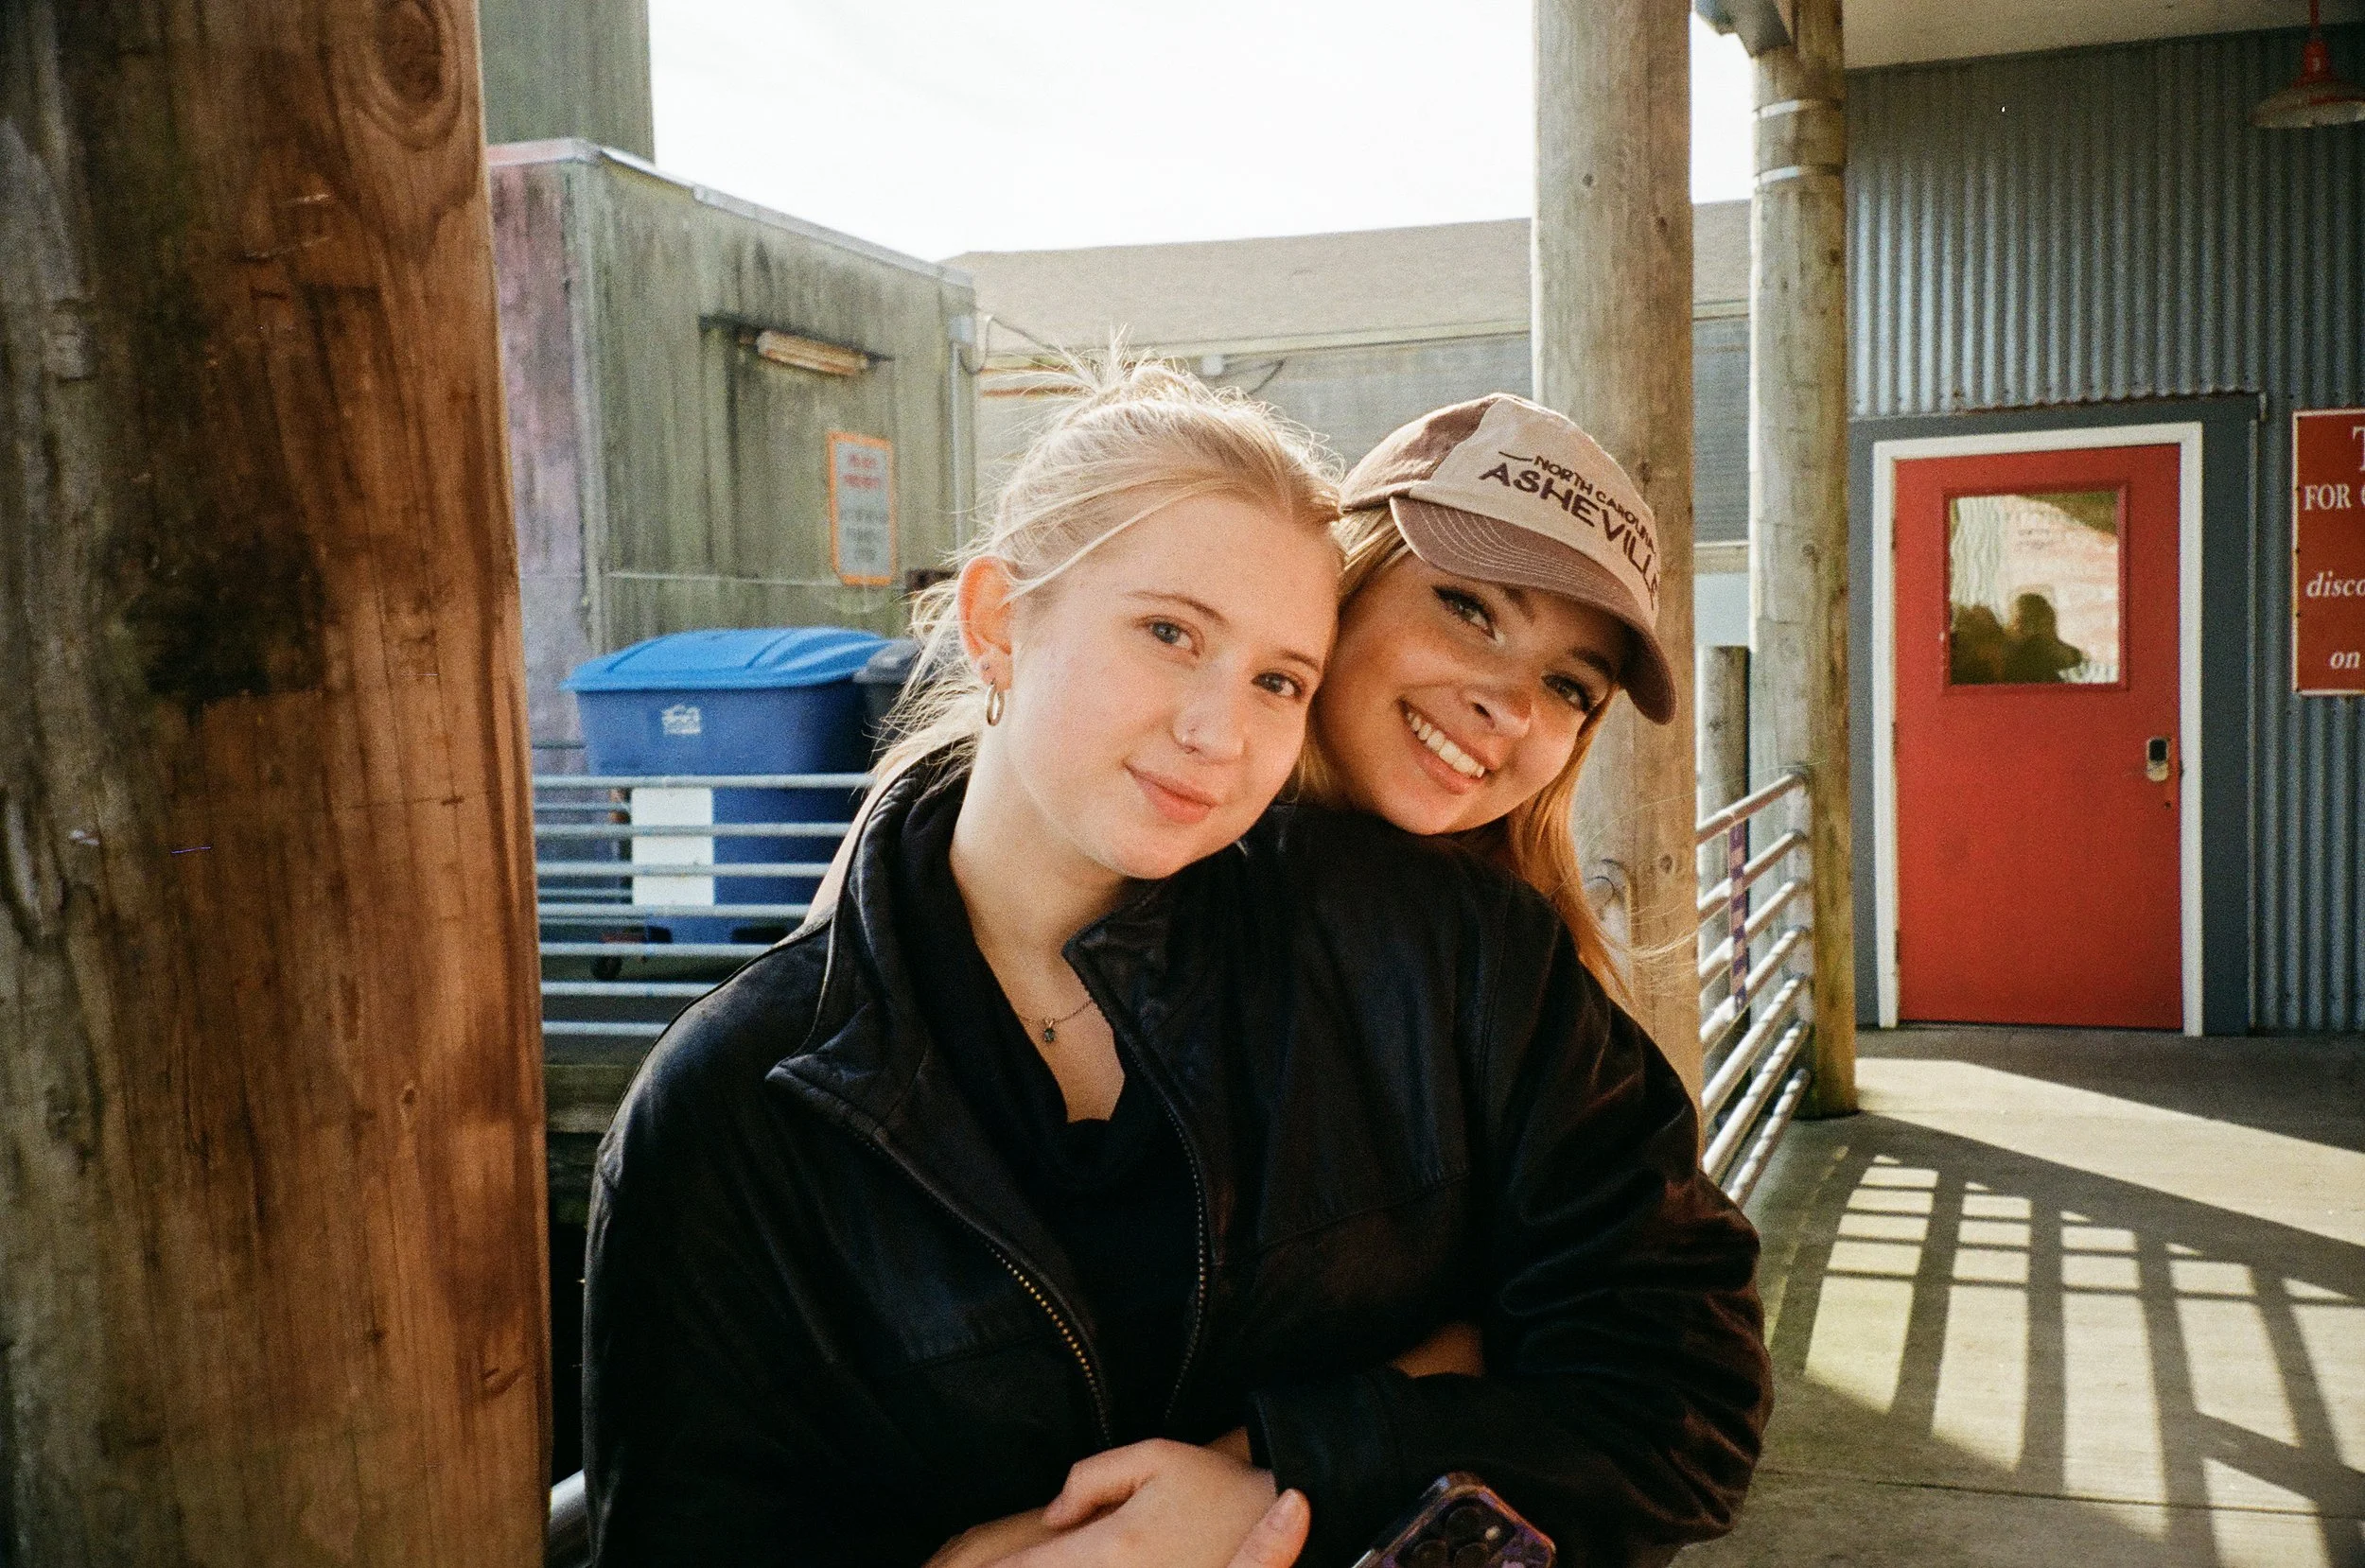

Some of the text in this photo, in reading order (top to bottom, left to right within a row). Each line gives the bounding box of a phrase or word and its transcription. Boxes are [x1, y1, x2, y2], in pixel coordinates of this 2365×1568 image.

[1533, 456, 1656, 554] NORTH CAROLINA
[2304, 483, 2352, 511] FOR
[2330, 651, 2360, 669] on
